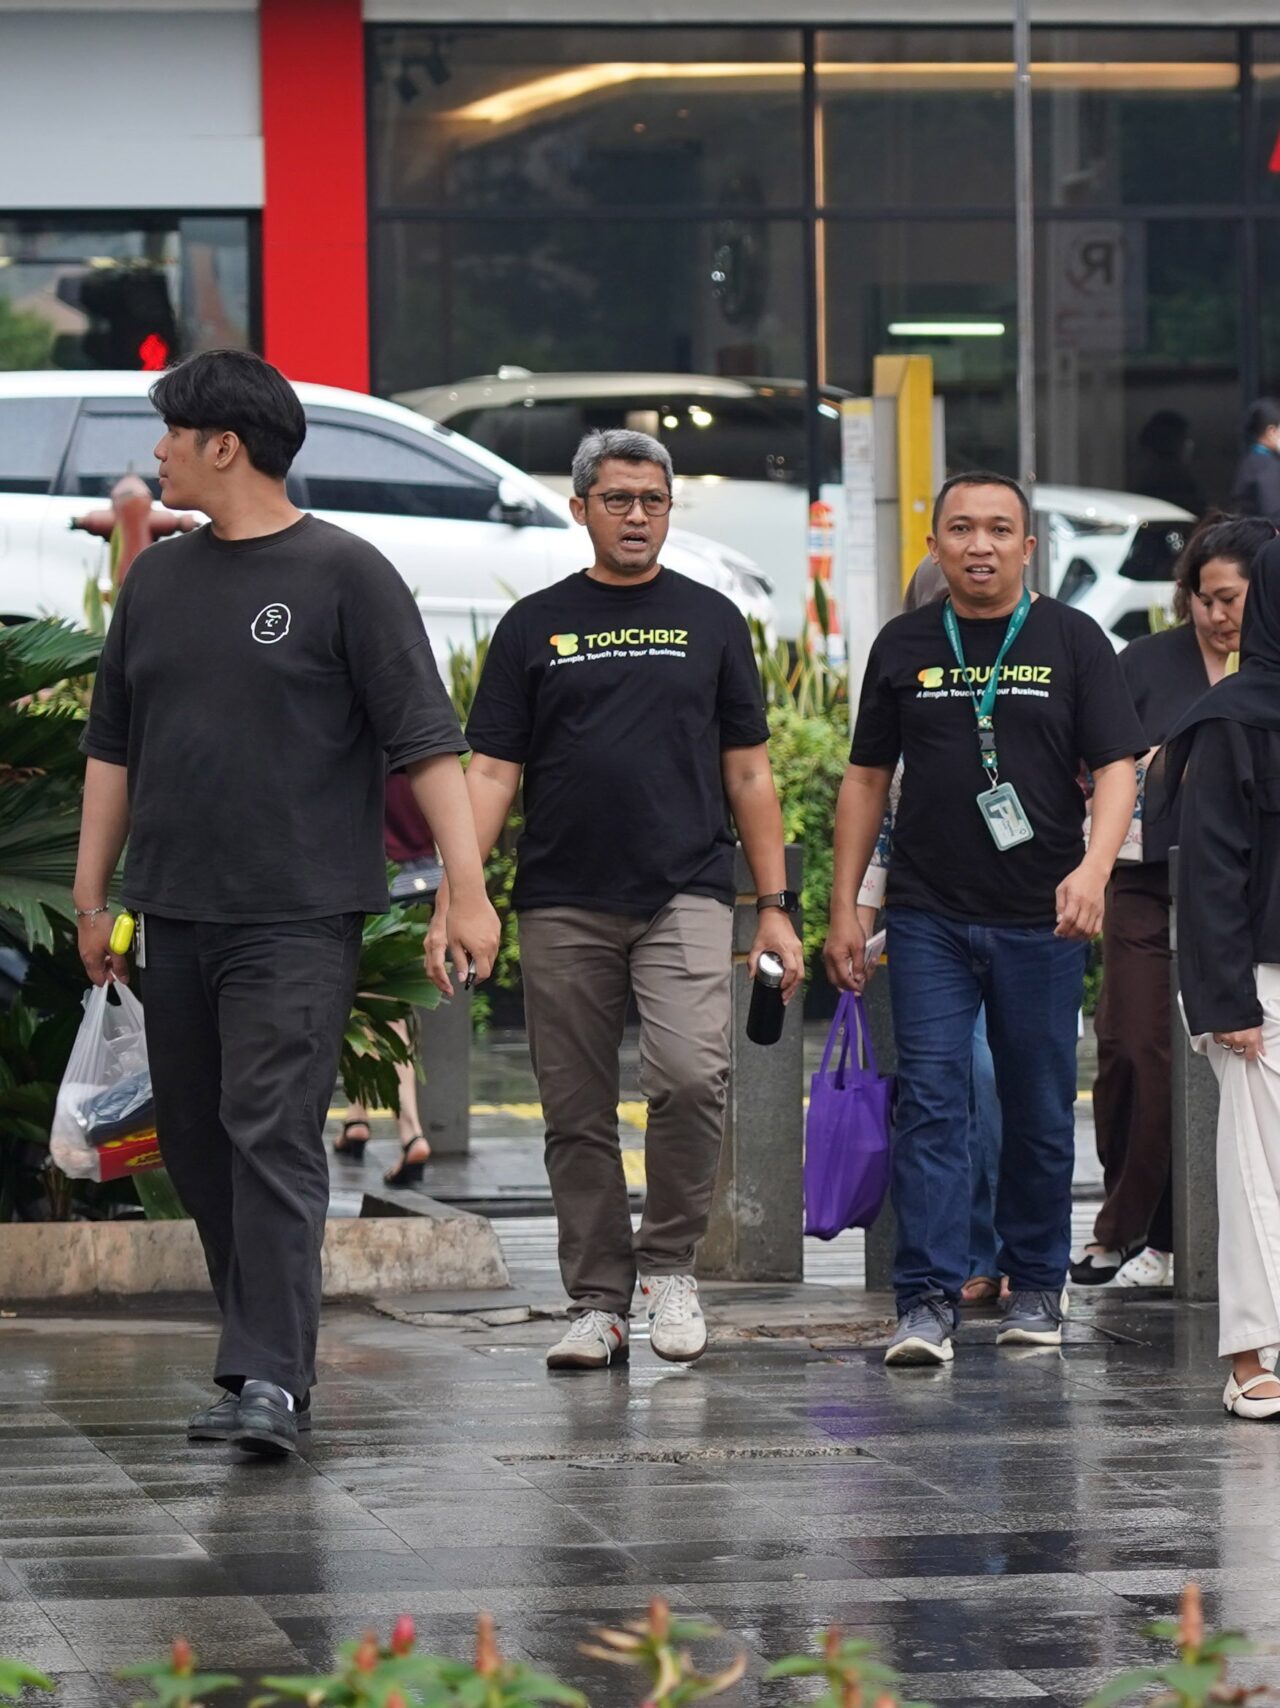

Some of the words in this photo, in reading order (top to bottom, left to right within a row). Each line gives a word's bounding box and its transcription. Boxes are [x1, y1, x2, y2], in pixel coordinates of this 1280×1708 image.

[584, 628, 688, 649] TOUCHBIZ
[557, 655, 585, 665] Simple
[586, 650, 612, 661] Touch
[613, 649, 628, 657] For
[628, 648, 648, 657] Your
[648, 648, 686, 658] Business
[923, 689, 948, 699] Simple
[950, 689, 975, 698] Touch
[1011, 687, 1050, 698] Business
